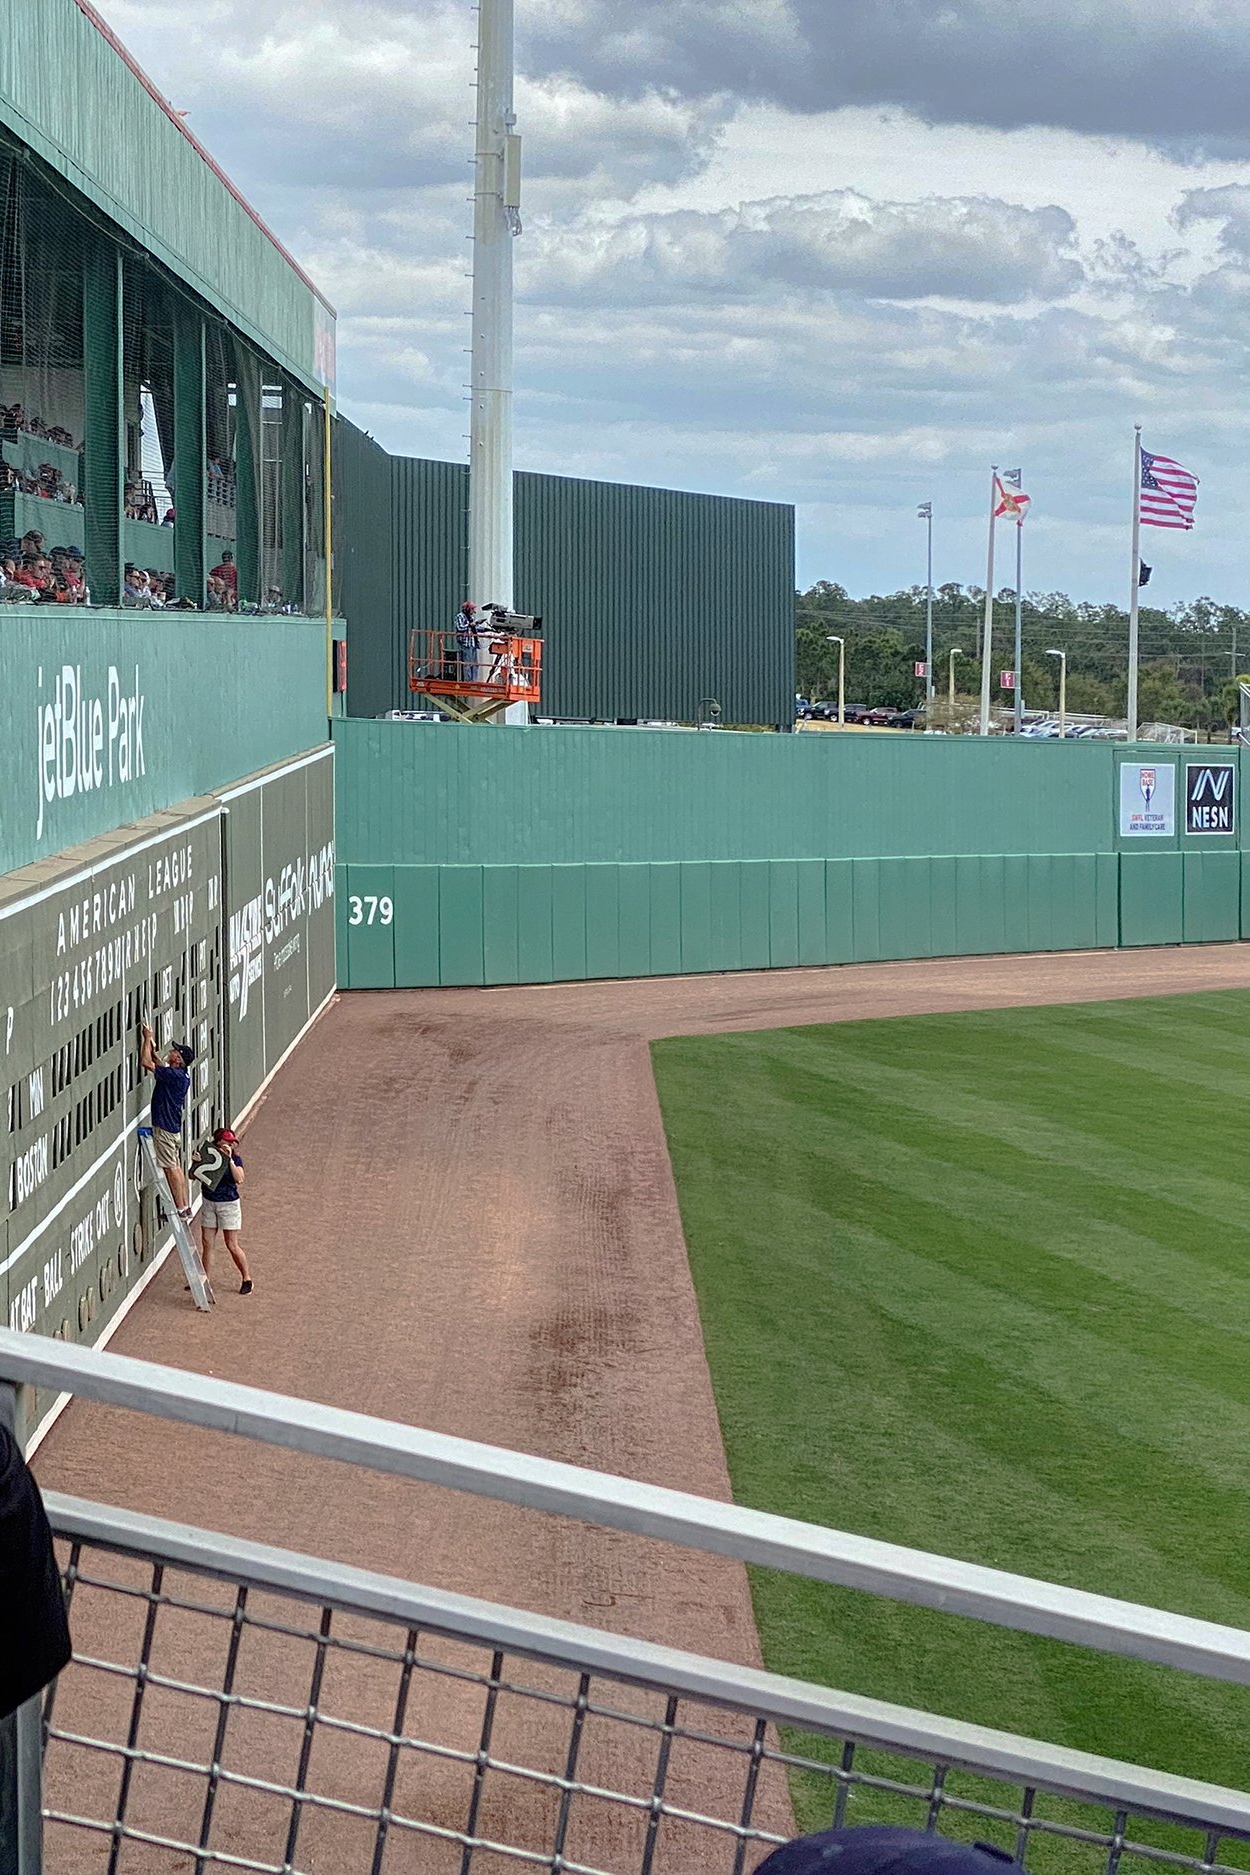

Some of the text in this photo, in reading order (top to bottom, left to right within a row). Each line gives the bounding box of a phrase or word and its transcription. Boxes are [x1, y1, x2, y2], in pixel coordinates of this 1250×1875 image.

[36, 664, 146, 840] jetBlue Park
[1192, 806, 1229, 829] NESN
[57, 873, 136, 957] AMERICAN
[148, 844, 193, 900] LEAGUE
[348, 895, 394, 926] 379
[16, 1132, 49, 1204] BOSTON
[193, 1147, 223, 1186] 2
[10, 1189, 110, 1334] AT BAT BALL STRIKE OUT
